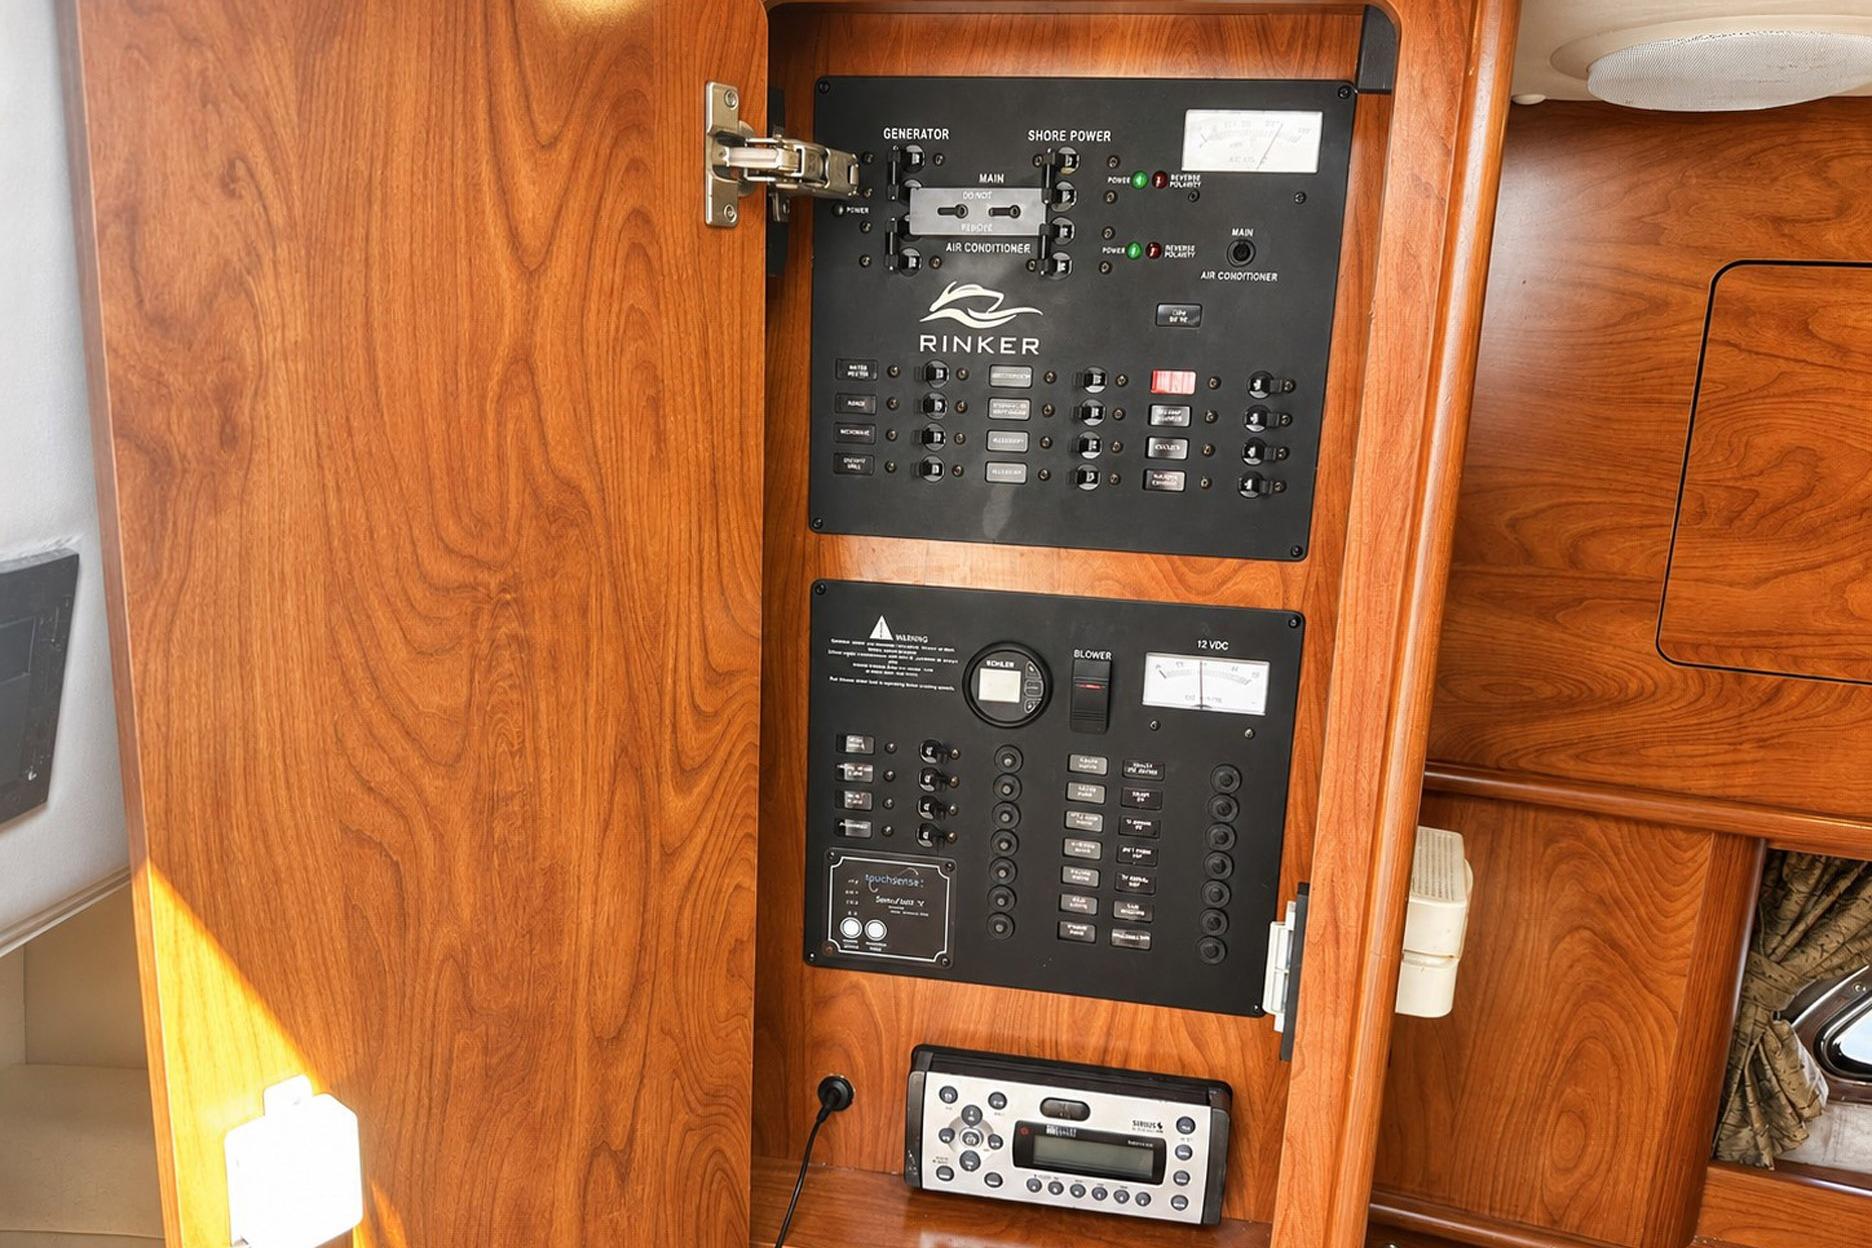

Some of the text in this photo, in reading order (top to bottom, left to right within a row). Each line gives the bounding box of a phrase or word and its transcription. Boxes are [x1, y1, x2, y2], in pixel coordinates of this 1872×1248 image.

[883, 127, 950, 141] GENERATOR
[1027, 129, 1112, 142] SHORE POWER
[978, 172, 1005, 184] MAIN
[1231, 227, 1254, 238] MAIN
[945, 242, 1032, 255] AIR CONDITIONER
[1200, 270, 1279, 283] AIR CONDITIONER
[919, 334, 1041, 356] RINKER
[1197, 640, 1230, 651] 12 VDC
[1073, 649, 1113, 661] BLOWER
